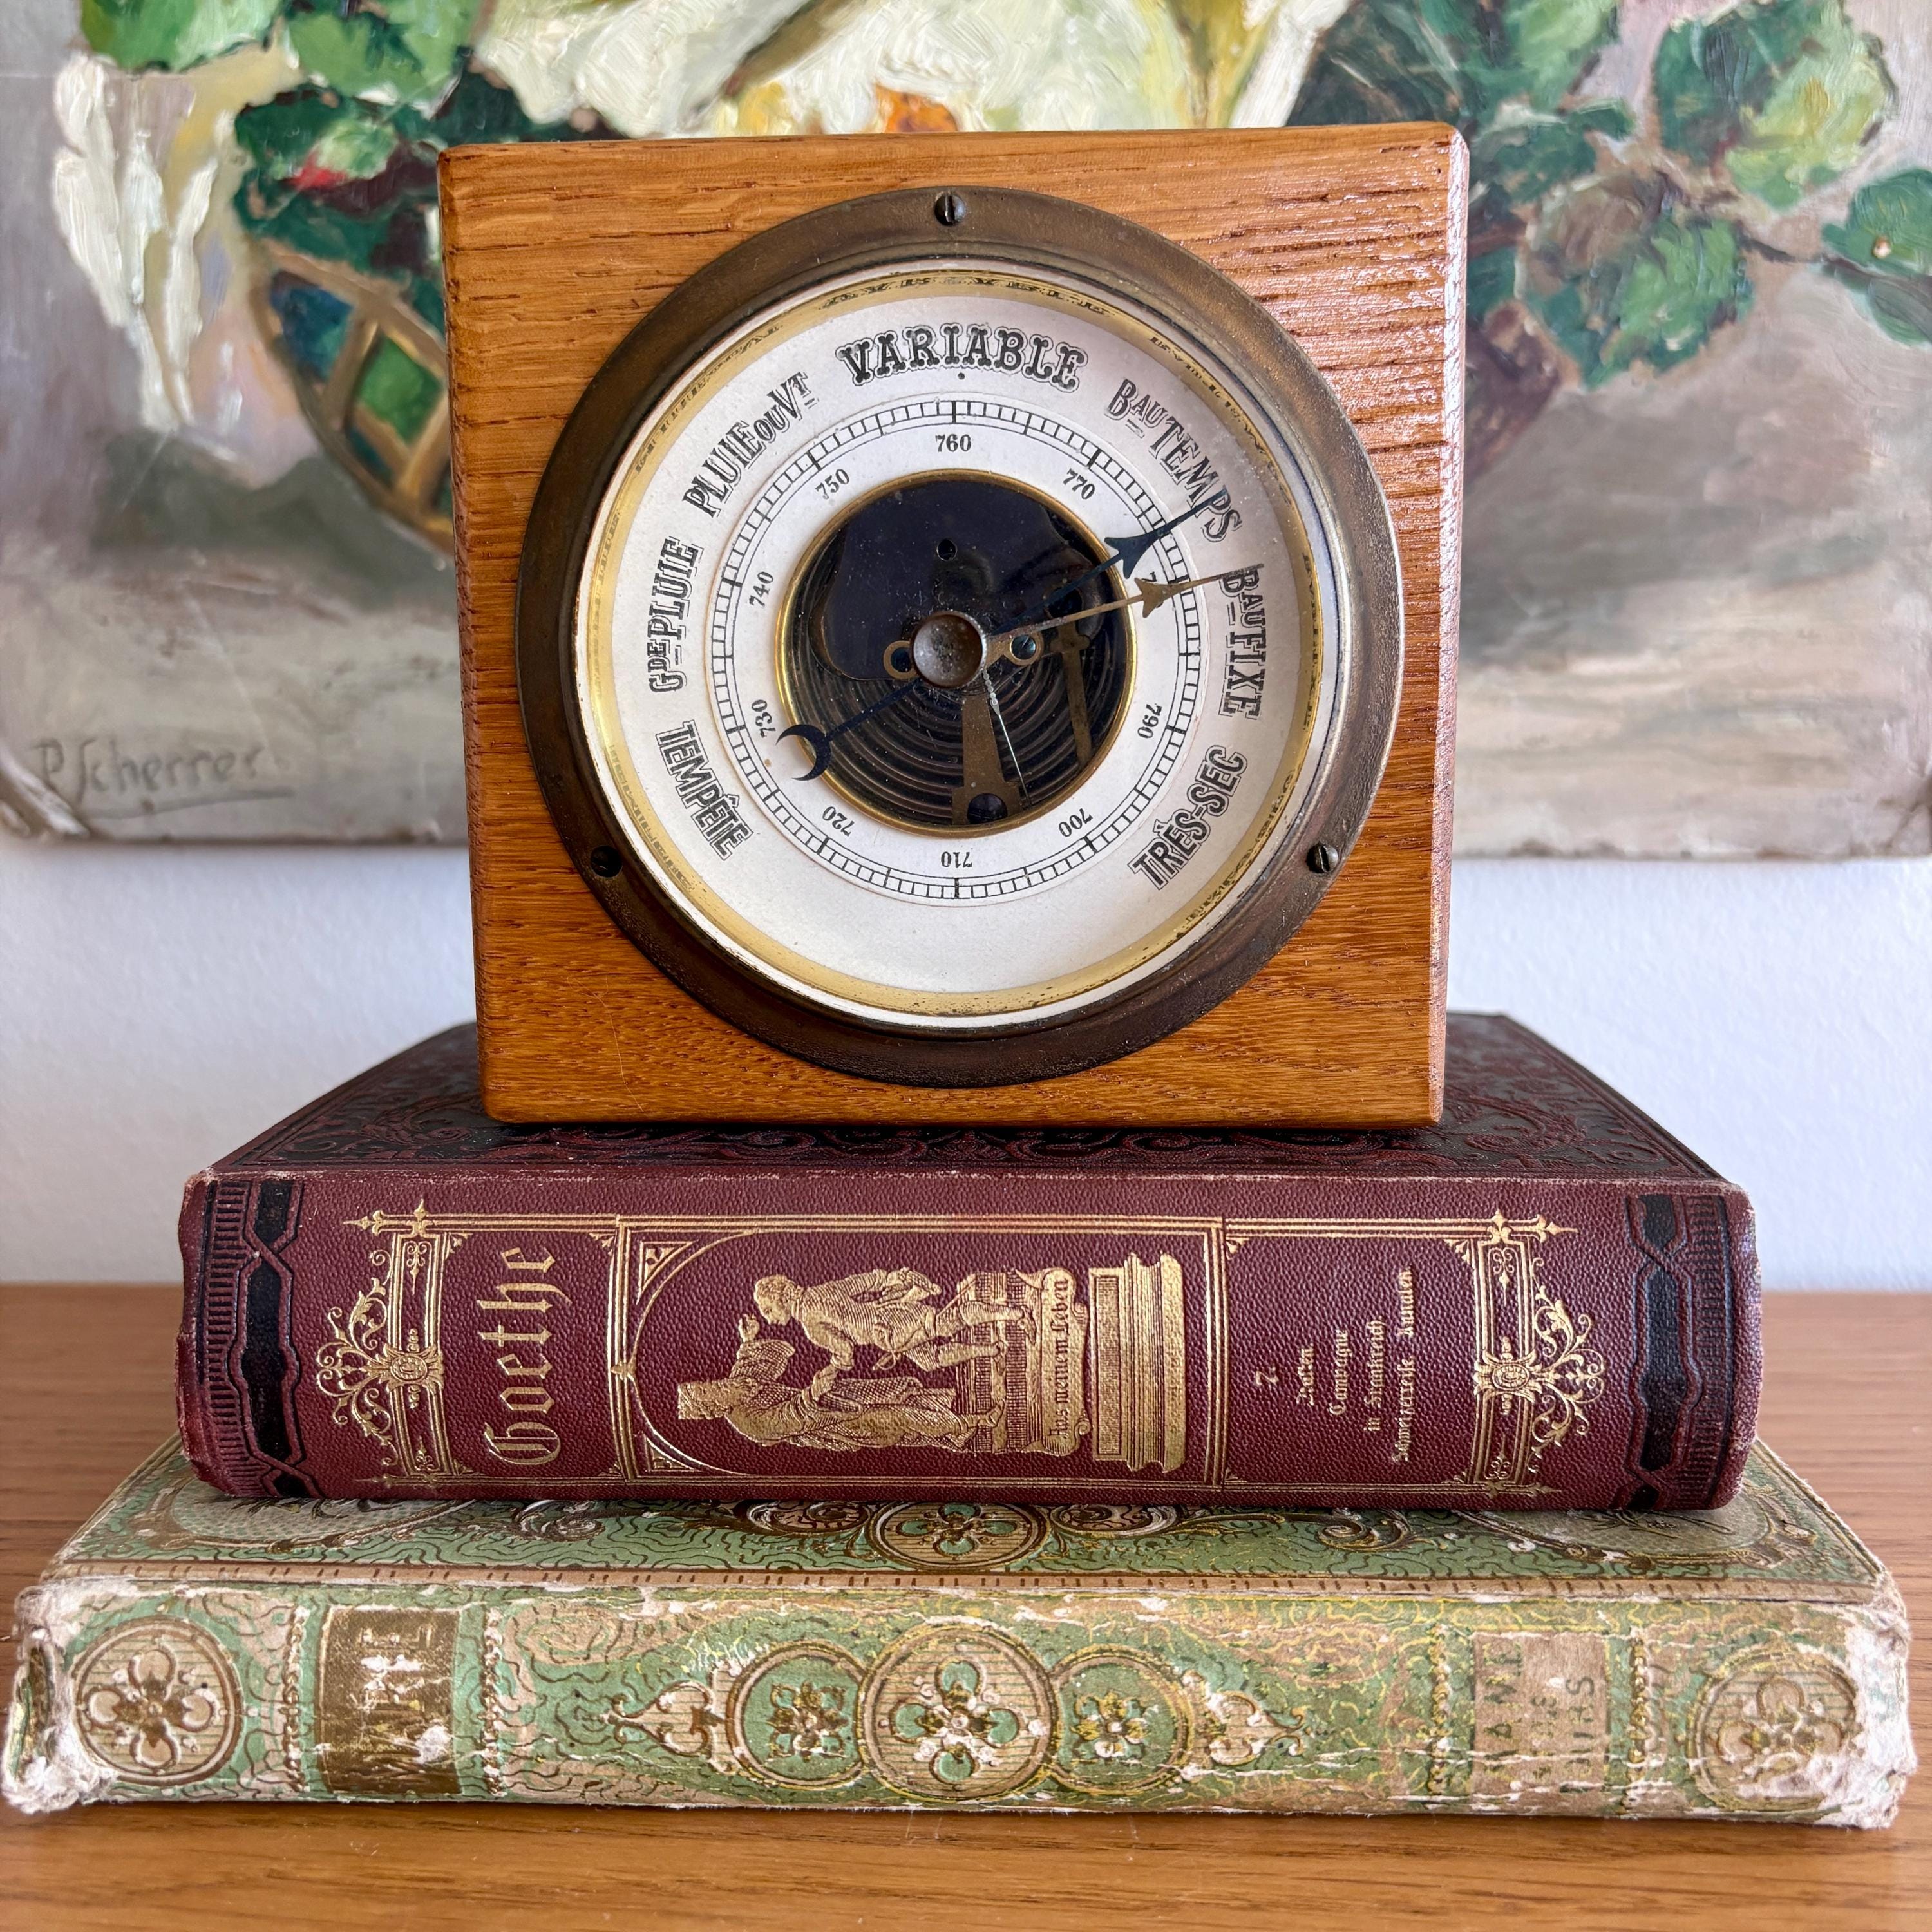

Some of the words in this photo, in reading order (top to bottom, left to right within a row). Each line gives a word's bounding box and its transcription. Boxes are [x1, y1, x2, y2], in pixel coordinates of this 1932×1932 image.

[835, 321, 1088, 393] VARIABLE
[935, 434, 971, 453] 760
[682, 420, 767, 518] PLUIE
[815, 468, 850, 500] 750
[1064, 469, 1095, 500] 770
[647, 535, 704, 640] PLUIE
[749, 571, 774, 607] 740
[1218, 626, 1267, 720] FIXE
[751, 699, 777, 738] 730
[1137, 703, 1162, 739] 790
[656, 720, 754, 860] TEMPÊTE
[822, 806, 855, 837] 720
[1059, 808, 1093, 837] 700
[1128, 744, 1248, 890] TRÈS-SEC
[940, 851, 973, 868] 710
[1049, 1278, 1069, 1336] Leben
[477, 1247, 572, 1465] Goethe
[1048, 1340, 1069, 1404] meinem
[1363, 1417, 1381, 1432] in
